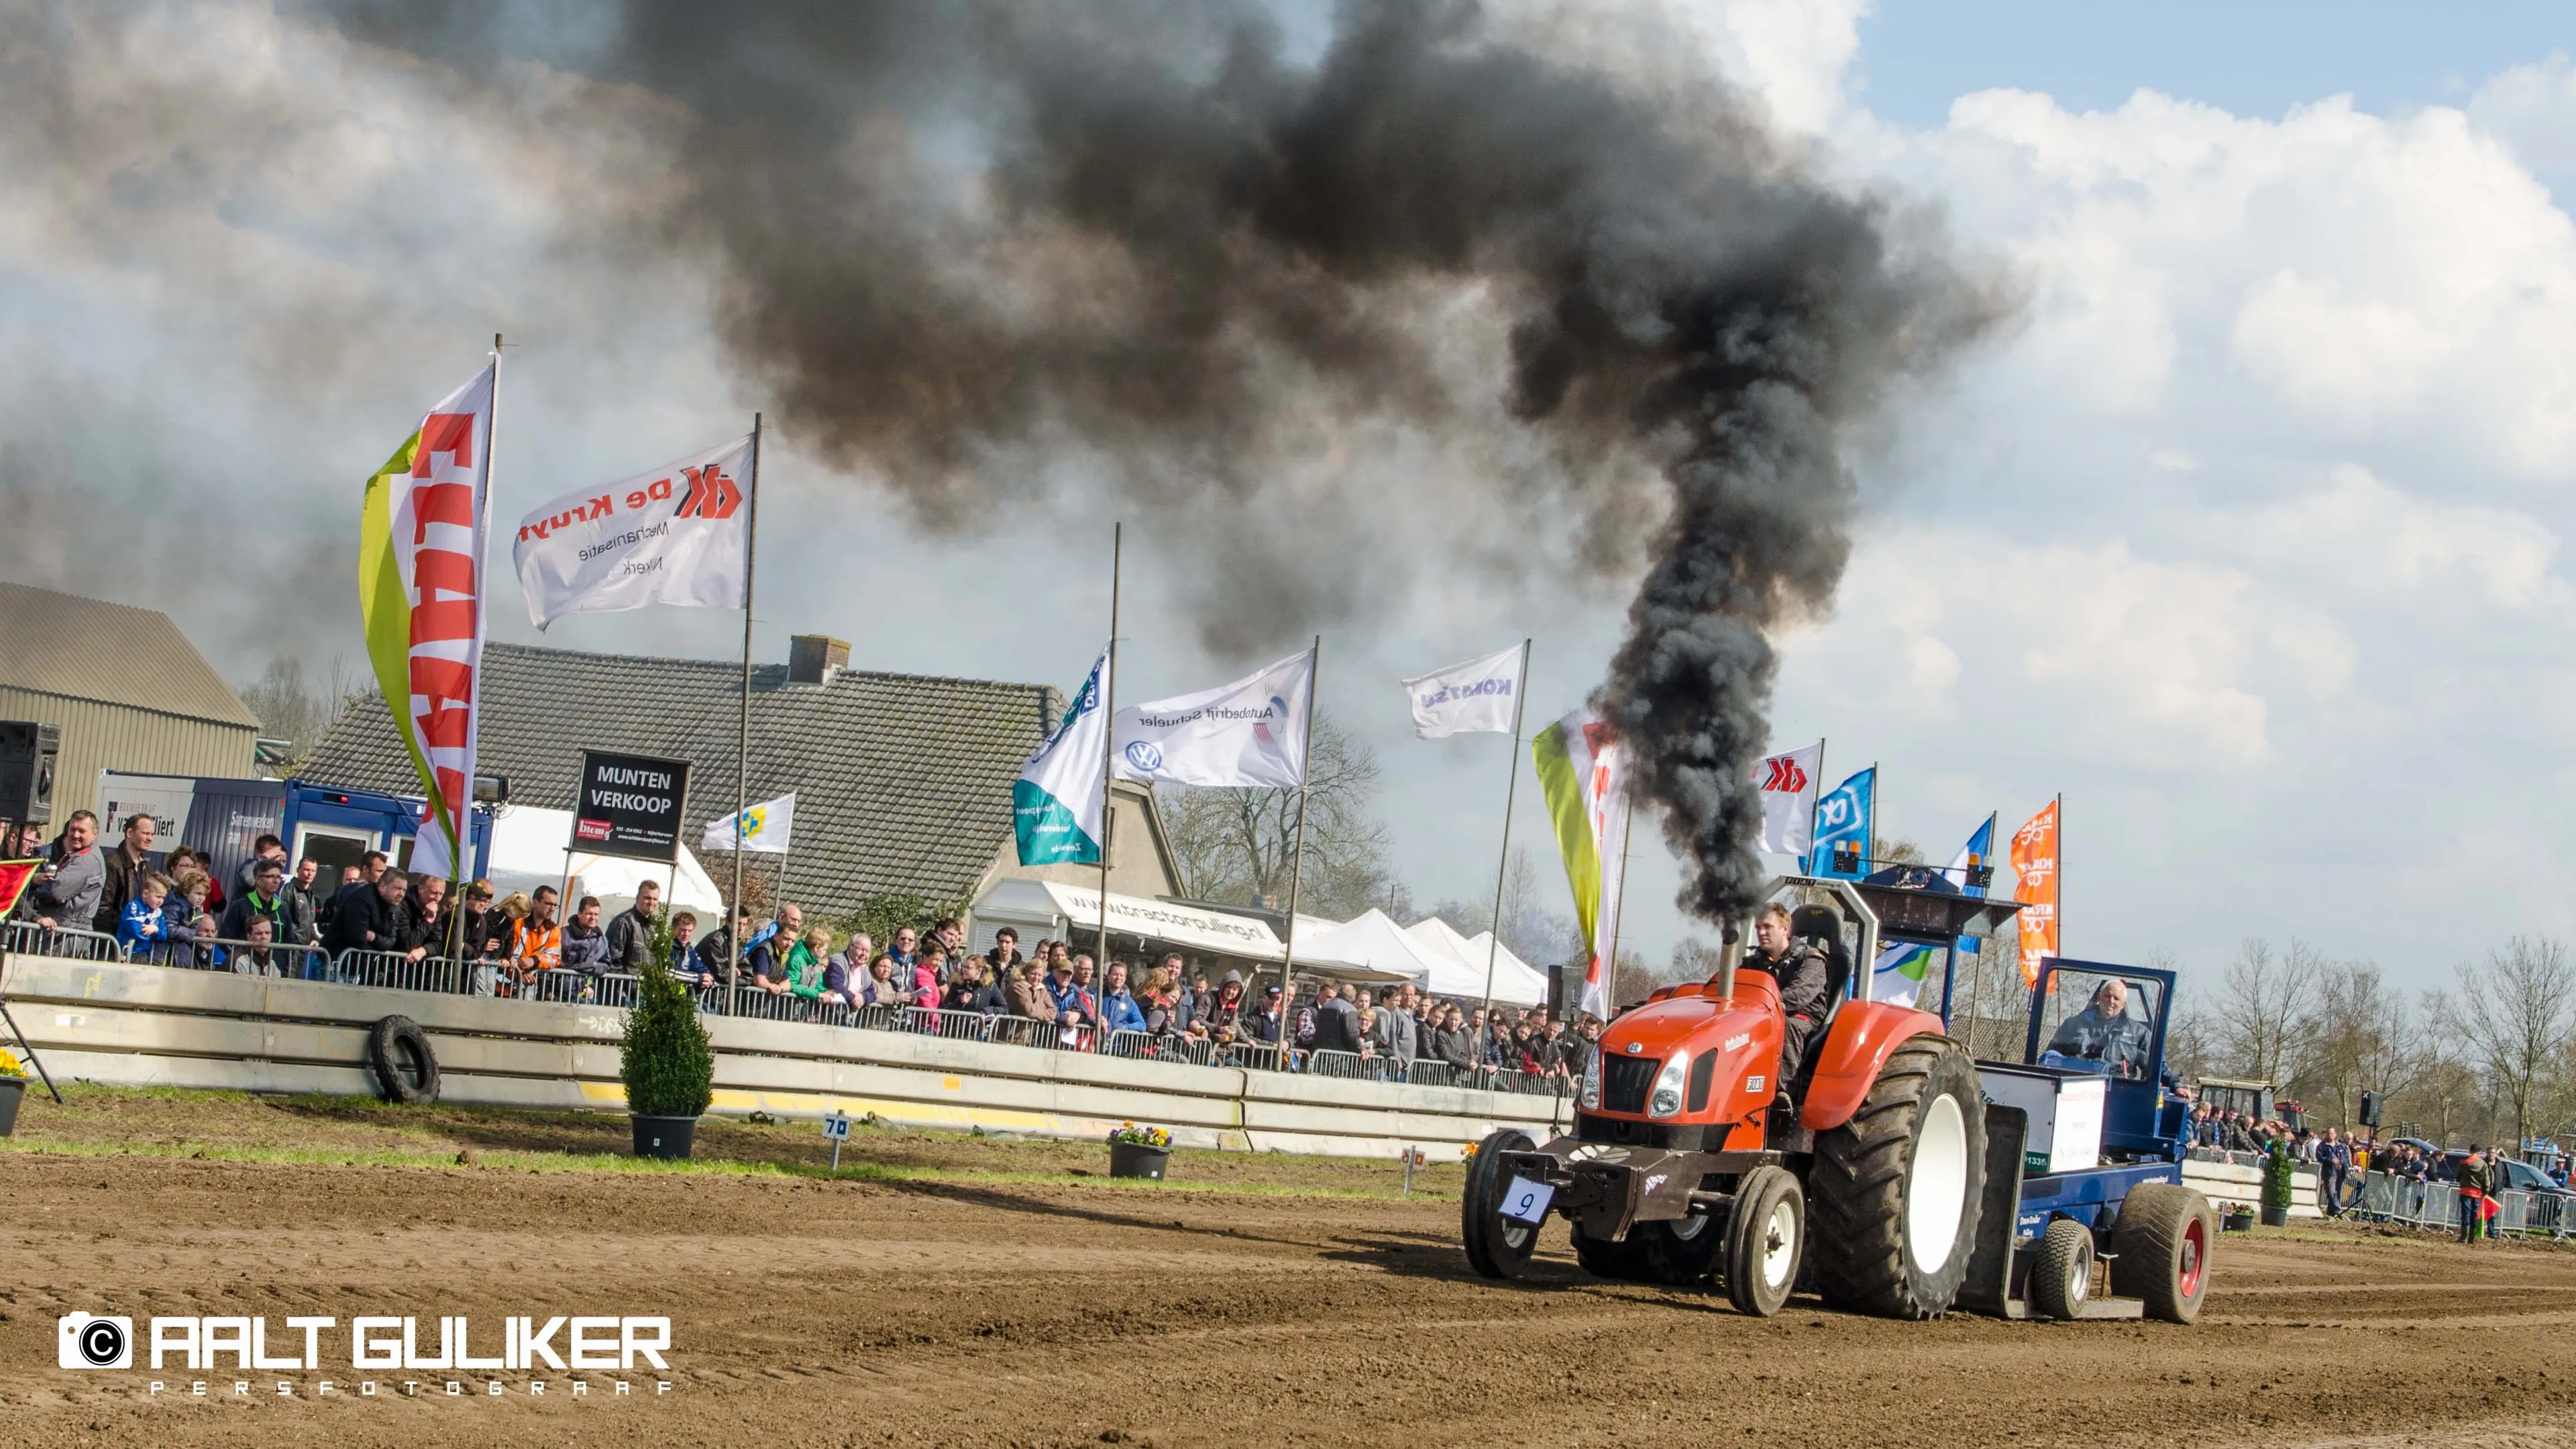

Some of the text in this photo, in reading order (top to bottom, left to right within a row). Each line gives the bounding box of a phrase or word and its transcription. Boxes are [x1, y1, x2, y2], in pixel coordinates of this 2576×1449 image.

[597, 765, 672, 790] MUNTEN
[591, 789, 672, 814] VERKOOP
[1067, 896, 1266, 941] www.tractorpulling.nl
[825, 1118, 847, 1135] 70
[1514, 1193, 1535, 1216] 9
